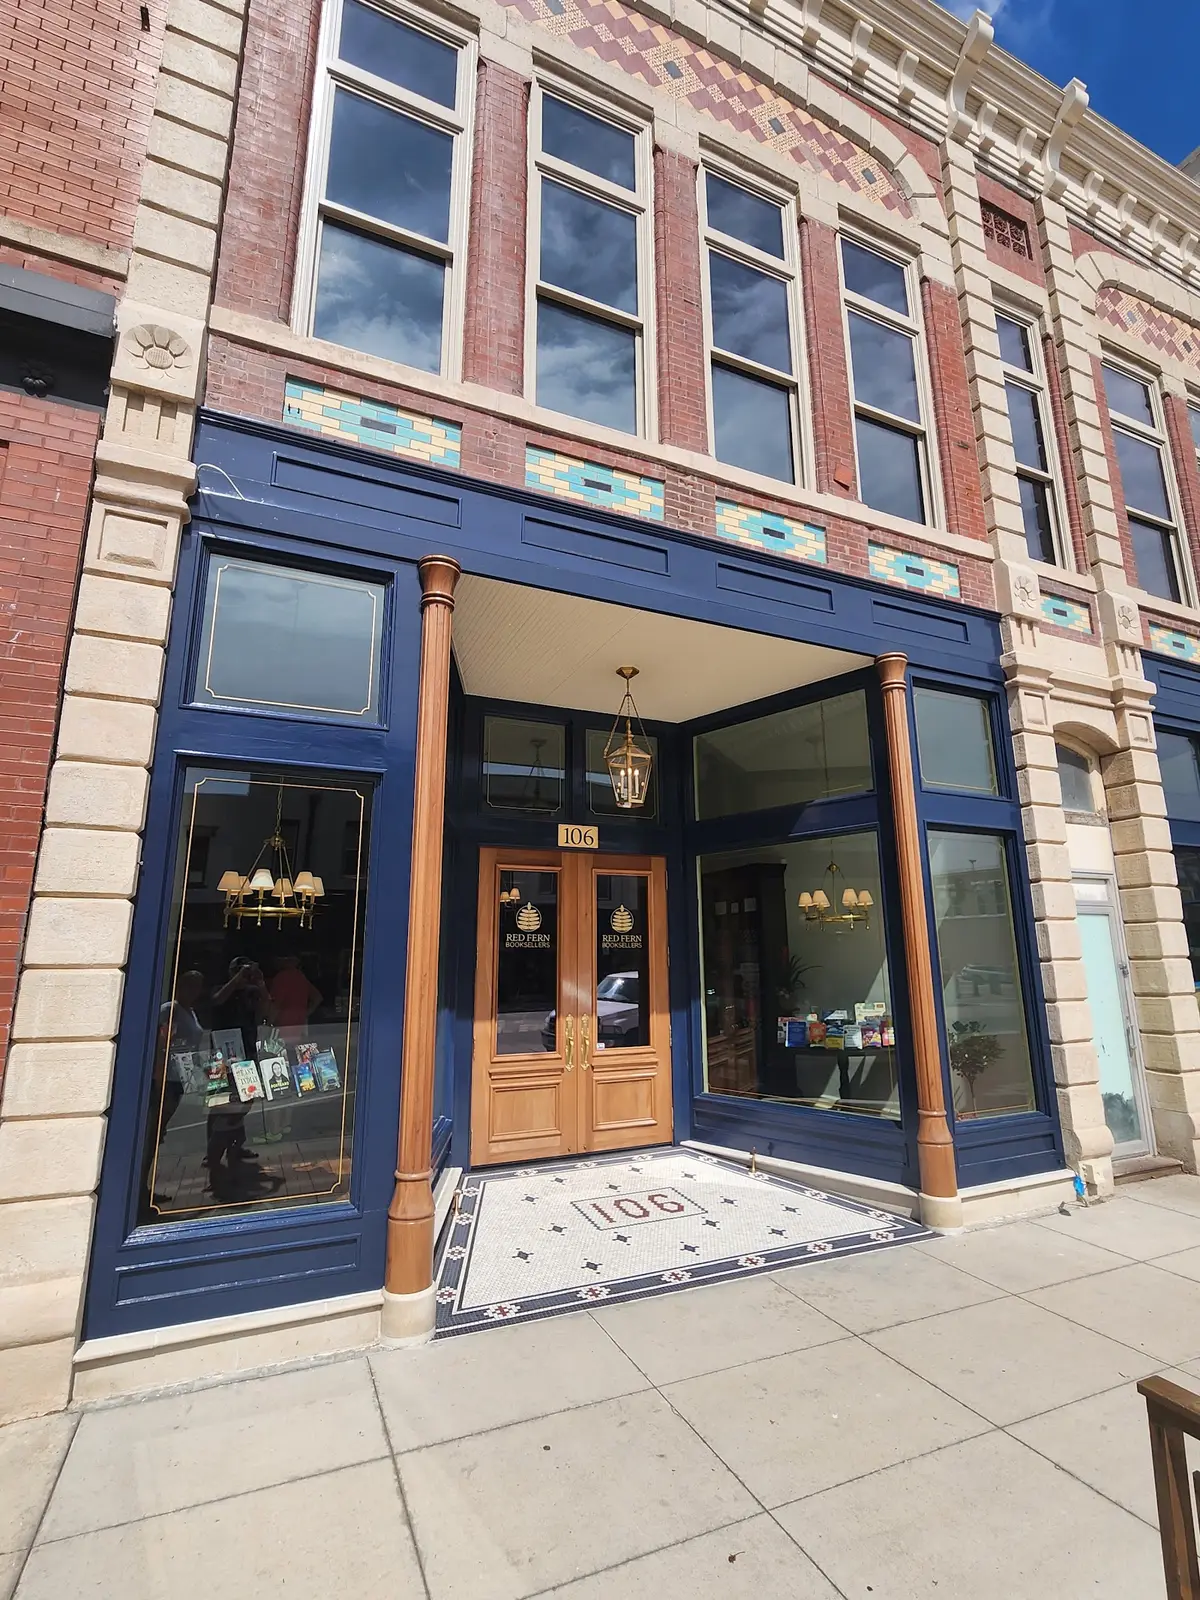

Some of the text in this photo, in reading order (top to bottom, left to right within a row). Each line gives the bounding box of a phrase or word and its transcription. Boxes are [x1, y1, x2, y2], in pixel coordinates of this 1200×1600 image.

[563, 827, 594, 846] 106
[506, 933, 551, 942] RED FERN
[602, 934, 642, 943] RED FERN
[505, 941, 551, 949] BOOKSELLERS
[602, 941, 643, 949] BOOKSELLERS
[590, 1193, 685, 1224] 106
